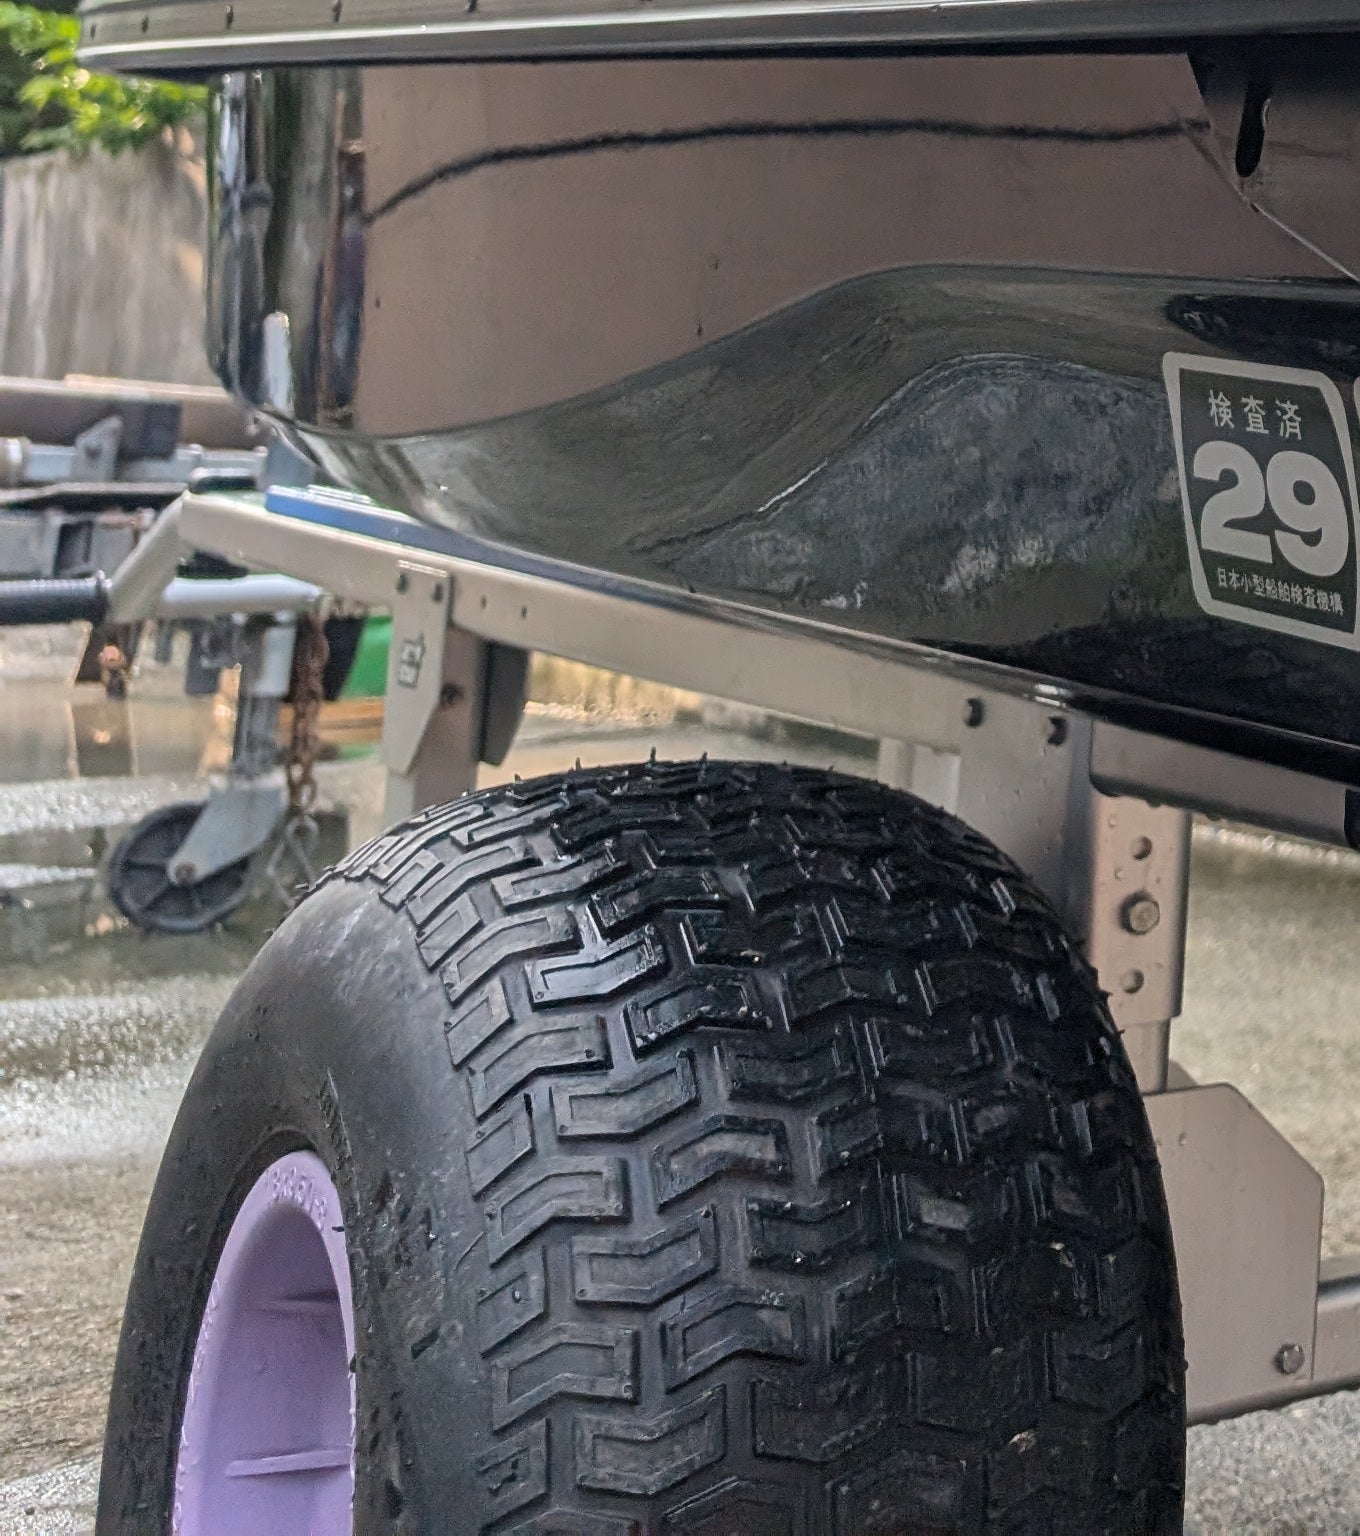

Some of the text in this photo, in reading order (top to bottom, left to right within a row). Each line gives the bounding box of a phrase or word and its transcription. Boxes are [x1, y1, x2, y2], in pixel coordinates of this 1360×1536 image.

[1208, 389, 1302, 441] 検査済
[1193, 440, 1349, 577] 29
